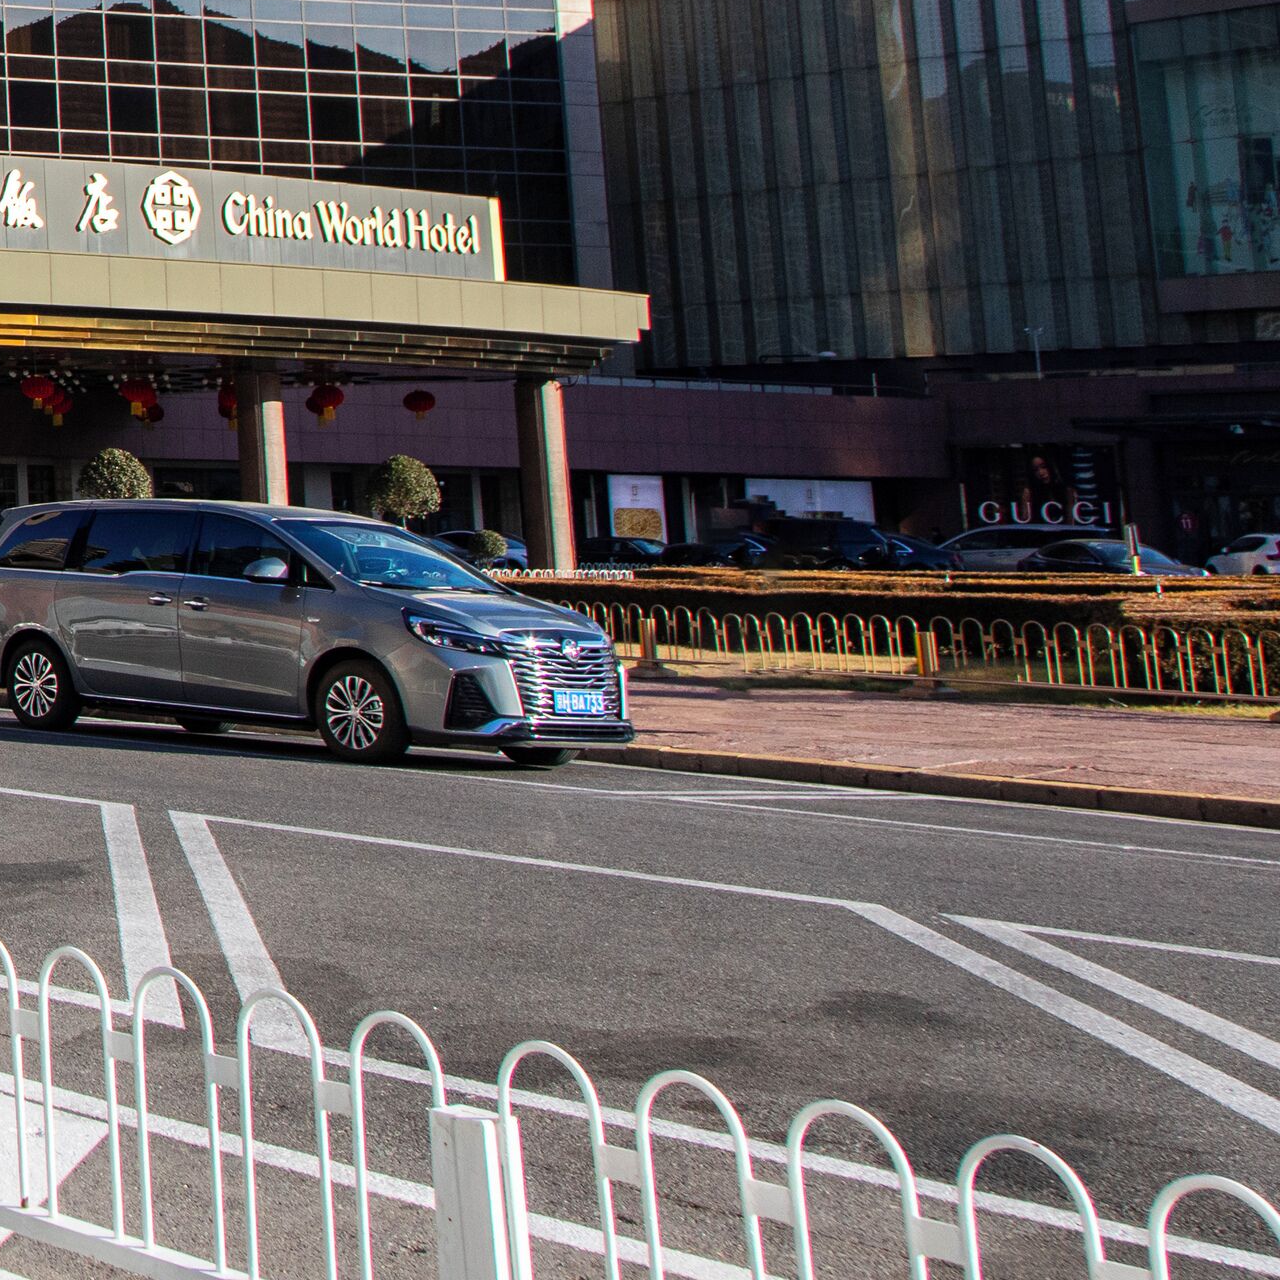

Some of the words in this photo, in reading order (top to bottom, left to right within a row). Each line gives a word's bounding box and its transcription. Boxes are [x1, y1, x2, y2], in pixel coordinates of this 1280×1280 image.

[222, 191, 313, 240] China
[314, 200, 402, 248] World
[404, 208, 480, 255] Hotel
[978, 501, 1113, 524] GUCCI
